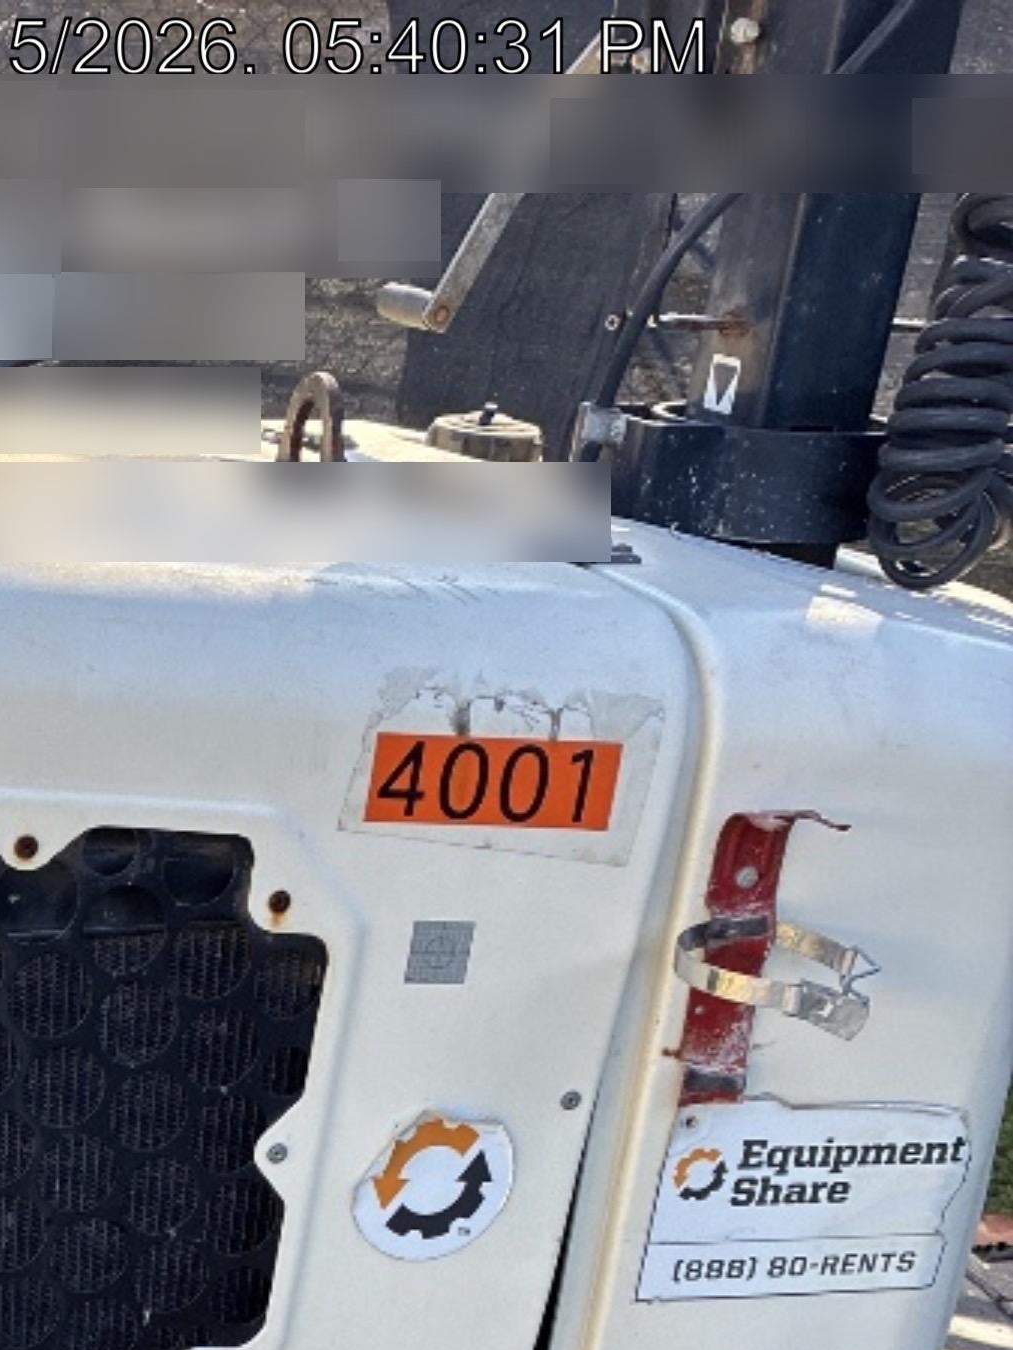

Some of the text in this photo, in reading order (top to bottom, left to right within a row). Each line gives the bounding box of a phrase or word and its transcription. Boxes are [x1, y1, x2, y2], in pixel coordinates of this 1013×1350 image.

[377, 740, 595, 823] 4001
[737, 1136, 967, 1174] Equipment
[730, 1176, 851, 1207] Share
[673, 1250, 919, 1284] (888) 80-RENTS
